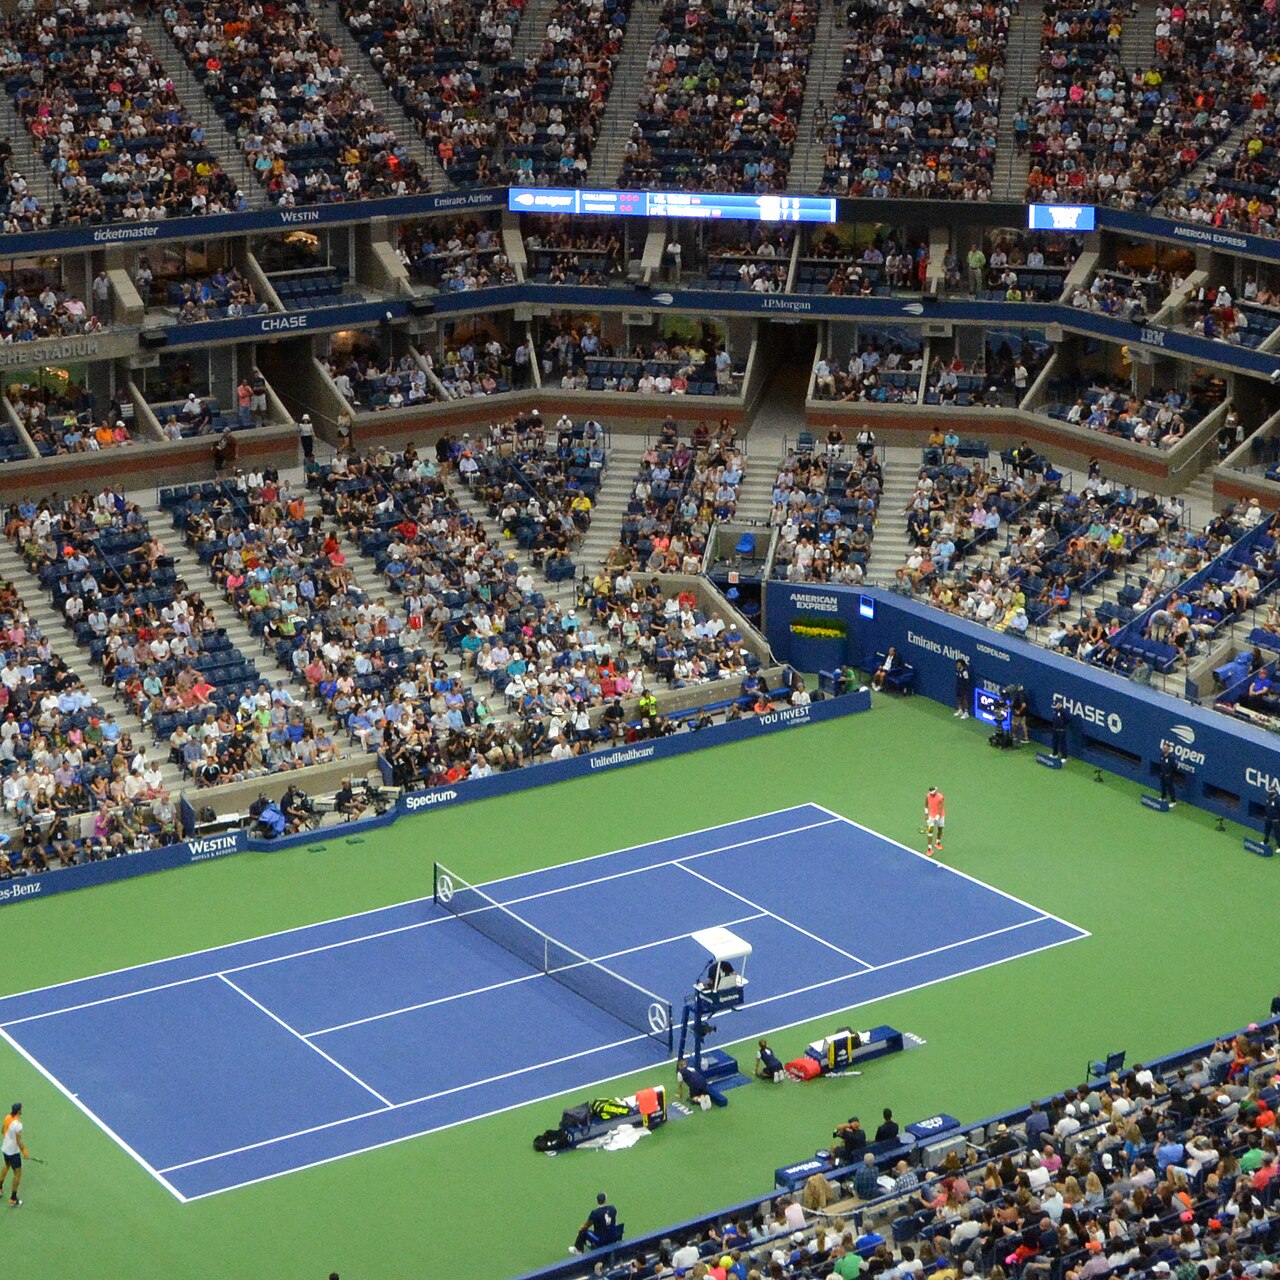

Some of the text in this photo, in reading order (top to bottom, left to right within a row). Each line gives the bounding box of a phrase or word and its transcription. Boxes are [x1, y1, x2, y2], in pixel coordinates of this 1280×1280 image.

[434, 194, 493, 207] Emirates Airline
[281, 211, 319, 222] WESTIN
[93, 226, 158, 241] ticketmaster
[1173, 227, 1247, 248] AMERICAN EXPRESS
[761, 299, 811, 311] J.P.Morgan
[261, 315, 308, 331] CHASE
[1140, 328, 1165, 347] IBM
[33, 341, 98, 361] STADIUM
[790, 593, 837, 604] AMERICAN
[796, 601, 838, 612] EXPRESS
[907, 631, 970, 666] Emirates Airline
[983, 680, 1000, 696] IBM
[760, 713, 778, 726] YOU
[780, 706, 810, 721] INVEST
[1052, 693, 1105, 727] CHASE
[590, 746, 654, 768] UnitedHealthcare
[1174, 744, 1205, 766] open
[1176, 761, 1196, 774] years
[406, 791, 454, 810] Spectrum
[188, 835, 236, 855] WESTIN
